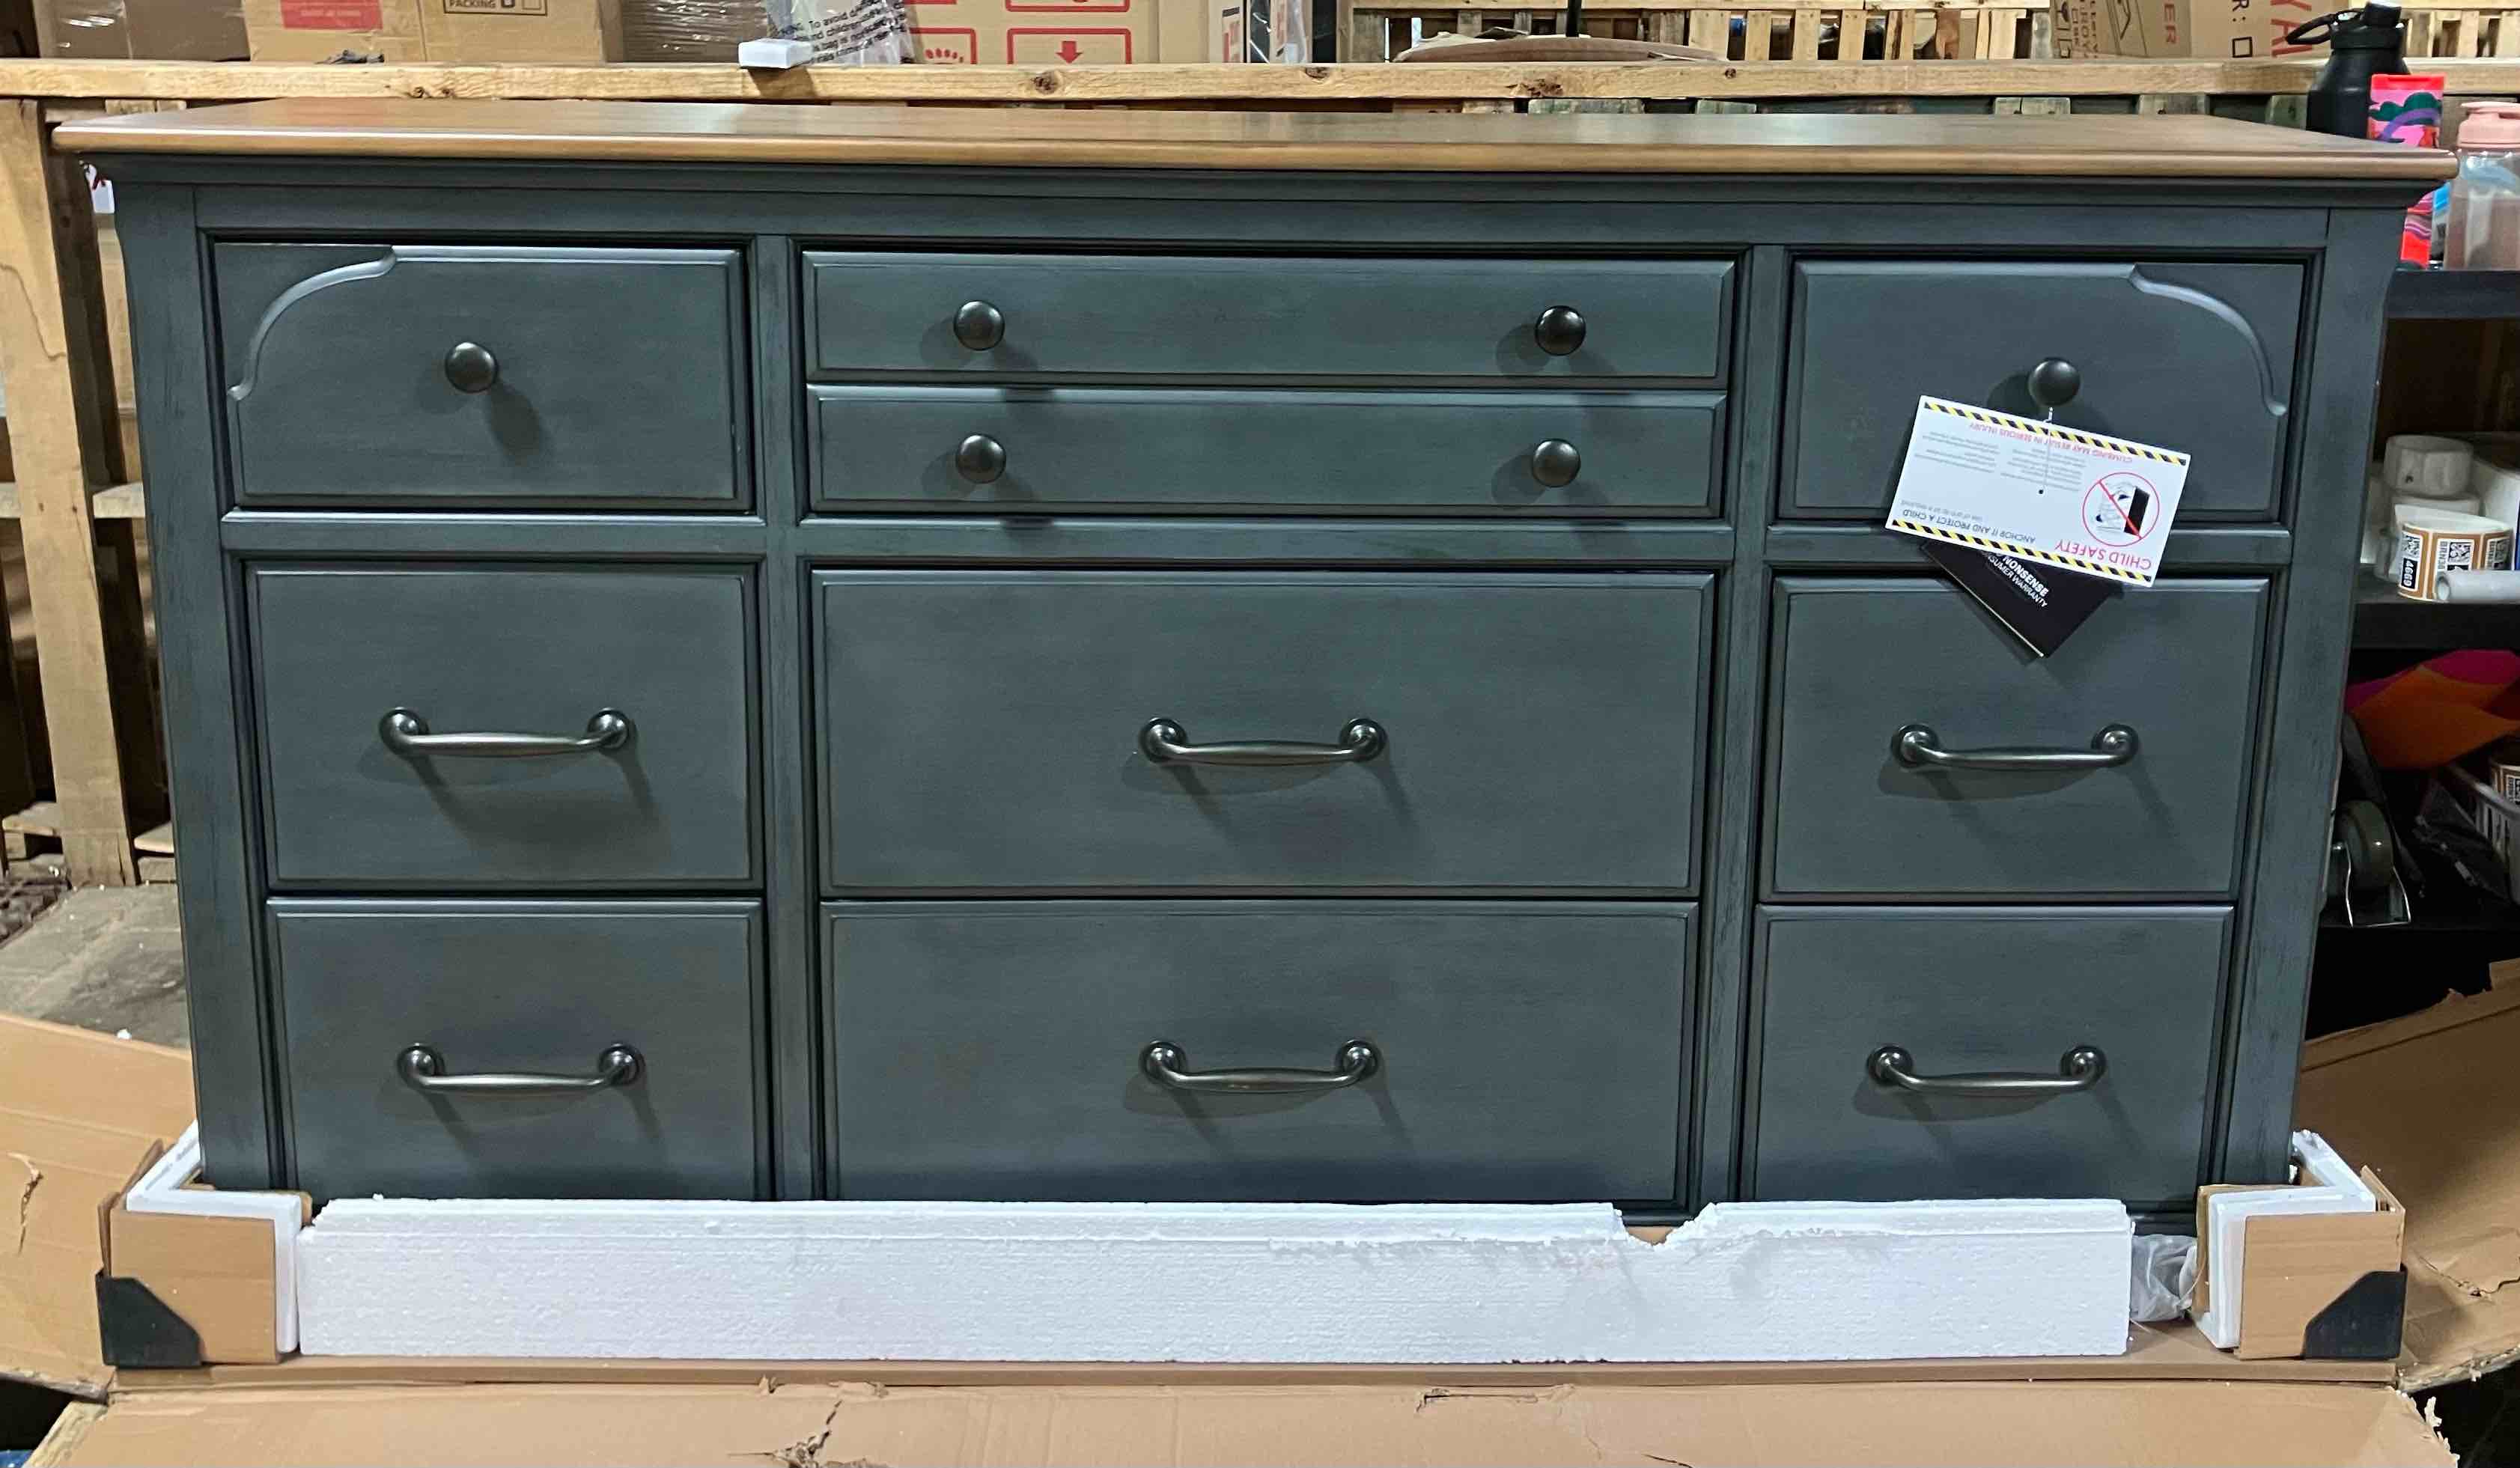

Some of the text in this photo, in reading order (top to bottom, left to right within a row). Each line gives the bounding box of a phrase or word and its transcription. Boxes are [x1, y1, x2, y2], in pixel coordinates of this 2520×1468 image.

[1902, 508, 1927, 521] CHILD
[1929, 514, 1935, 523] A
[1936, 516, 1970, 531] PROTECT
[1972, 524, 1990, 534] AND
[2000, 530, 2036, 545] ANCHOR
[2055, 539, 2152, 570] CHILD SAFETY
[2003, 556, 2049, 597] NONSENSE
[2012, 575, 2048, 607] WARRANTY
